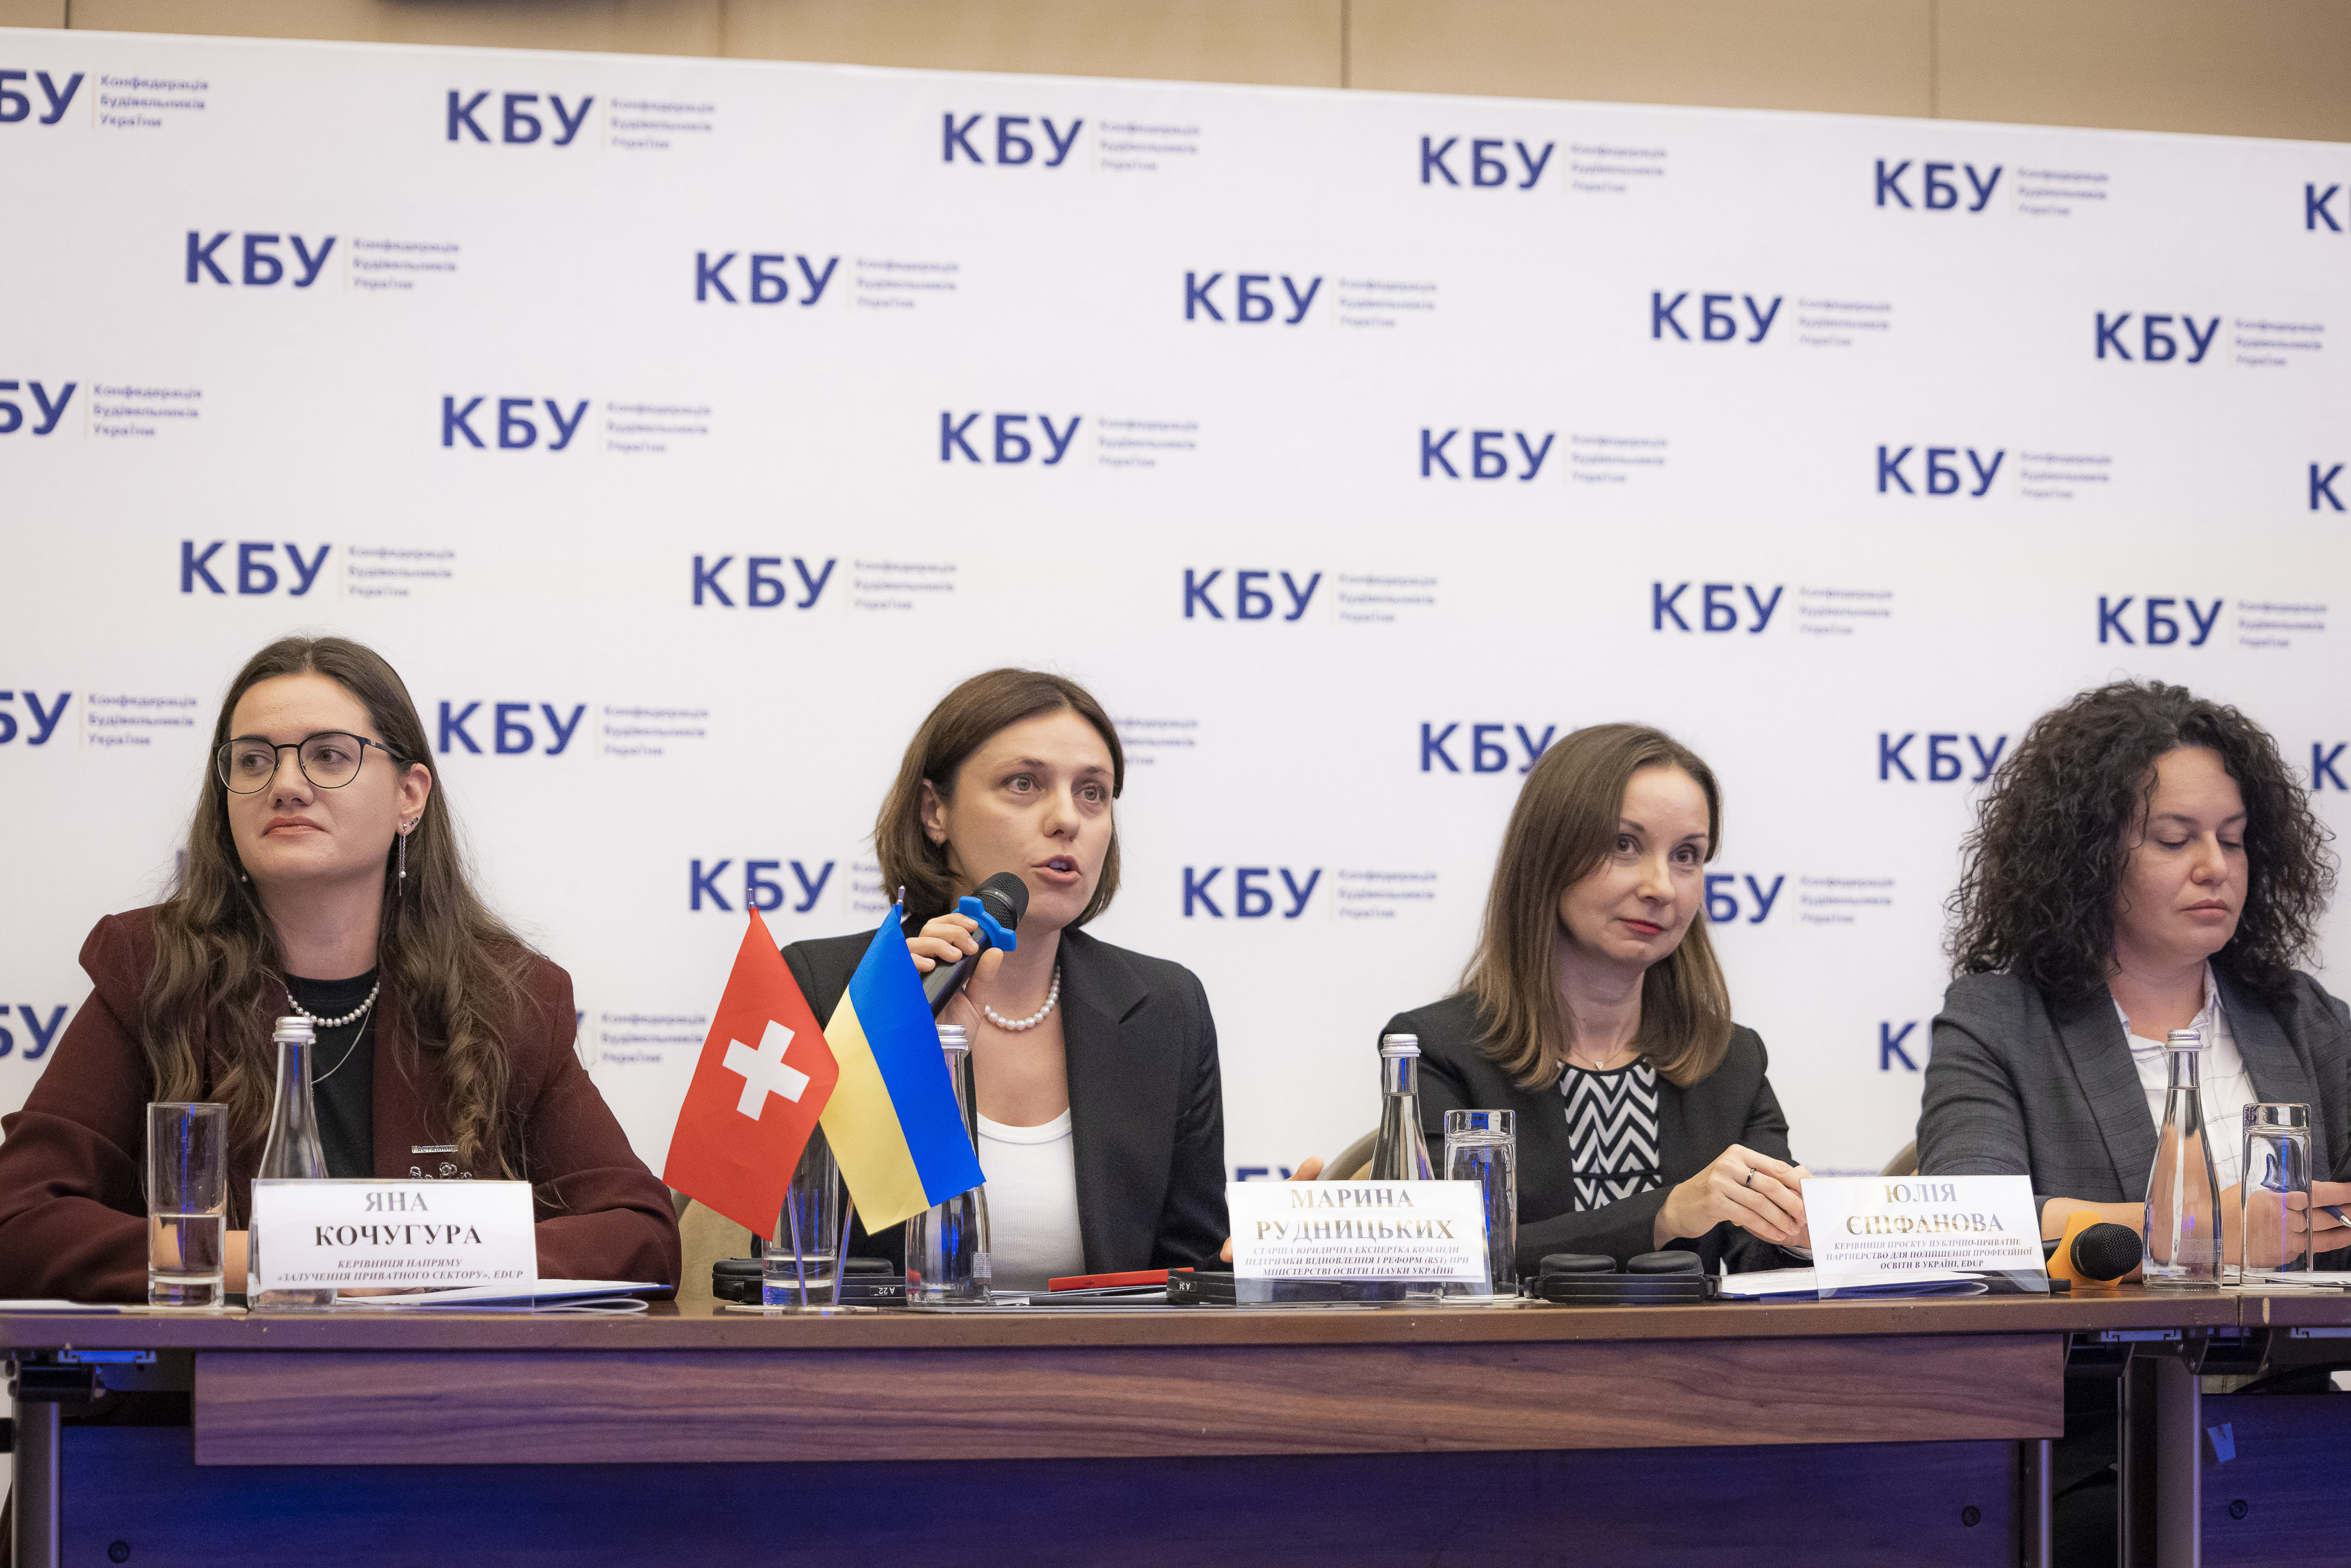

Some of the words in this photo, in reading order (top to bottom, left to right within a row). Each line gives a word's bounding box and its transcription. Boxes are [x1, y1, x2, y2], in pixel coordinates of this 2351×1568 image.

[0, 69, 85, 127] БУ
[447, 90, 596, 147] КБУ
[942, 112, 1085, 169] КБУ
[1420, 135, 1557, 192] КБУ
[1875, 158, 2005, 214] КБУ
[185, 231, 338, 289] КБУ
[695, 251, 842, 308] КБУ
[1184, 270, 1325, 326] КБУ
[1651, 290, 1785, 346] КБУ
[2094, 310, 2223, 365] КБУ
[0, 380, 77, 437] БУ
[441, 395, 592, 452] КБУ
[940, 410, 1084, 467] КБУ
[1420, 427, 1558, 483] КБУ
[1876, 445, 2007, 499] КБУ
[180, 540, 333, 597] КБУ
[693, 554, 838, 610] КБУ
[1183, 568, 1323, 624] КБУ
[1652, 581, 1785, 636] КБУ
[2098, 595, 2225, 648] КБУ
[438, 700, 588, 758] КБУ
[1420, 720, 1558, 777] КБУ
[1878, 731, 2009, 785] КБУ
[689, 859, 837, 915] КБУ
[1182, 866, 1324, 920] КБУ
[1704, 873, 1787, 925] БУ
[411, 1145, 458, 1153] НАСТАВНИЦ
[365, 1191, 429, 1212] ЯНА
[1290, 1188, 1415, 1208] МАРИНА
[1884, 1183, 1958, 1204] ЮЛІЯ
[314, 1224, 483, 1247] КОЧУГУРА
[1255, 1220, 1456, 1244] РУДНИЦЬКИХ
[1297, 1247, 1353, 1255] ЮРИДИЧНА
[1355, 1246, 1410, 1254] ЕКСПЕРТКА
[1412, 1246, 1460, 1254] КОМАНДИ
[1834, 1241, 1886, 1250] КЕРІВНИЦЯ
[1929, 1238, 2022, 1247] ПУБЛІЧНО-ПРИВАТНЕ
[1846, 1213, 2005, 1235] ЄПІФАНОВА
[337, 1259, 403, 1269] КЕРІВНИЦЯ
[407, 1258, 463, 1267] НАПРЯМУ
[354, 1271, 429, 1280] ПРИВАТНОГО
[494, 1270, 523, 1279] EDUP
[1245, 1257, 1303, 1266] ПІДТРИМКИ
[1305, 1257, 1375, 1265] ВІДНОВЛЕННЯ
[1424, 1256, 1447, 1264] (RST)
[1263, 1268, 1331, 1276] МІНІСТЕРСТВІ
[1333, 1267, 1368, 1276] ОСВІТИ
[1412, 1265, 1454, 1274] УКРАЇНИ
[1826, 1252, 1888, 1261] ПАРТНЕРСТВО
[1973, 1247, 2033, 1256] ПРОФЕСІЙНОЇ
[1922, 1259, 1960, 1268] УКРАЇНІ,
